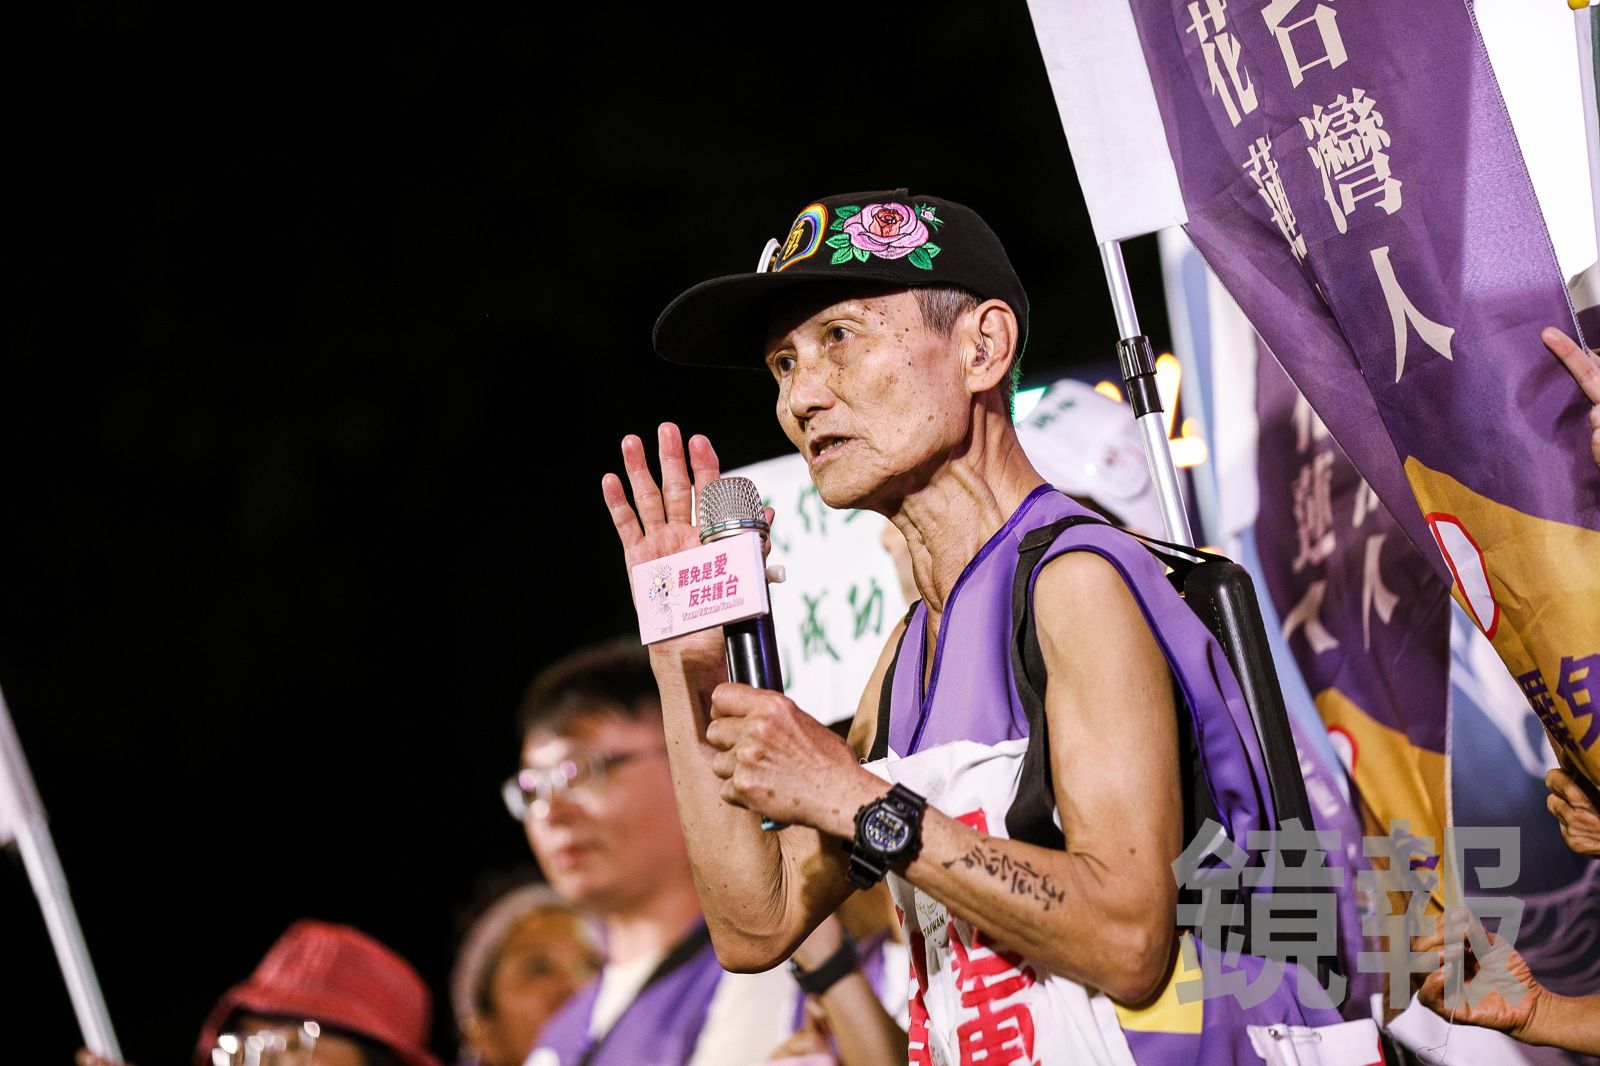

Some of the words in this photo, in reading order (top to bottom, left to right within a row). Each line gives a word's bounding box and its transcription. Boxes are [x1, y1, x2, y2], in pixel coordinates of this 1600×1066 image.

[1261, 0, 1455, 384] 台灣人
[678, 552, 728, 588] 罷免是愛
[688, 574, 739, 607] 反共護台
